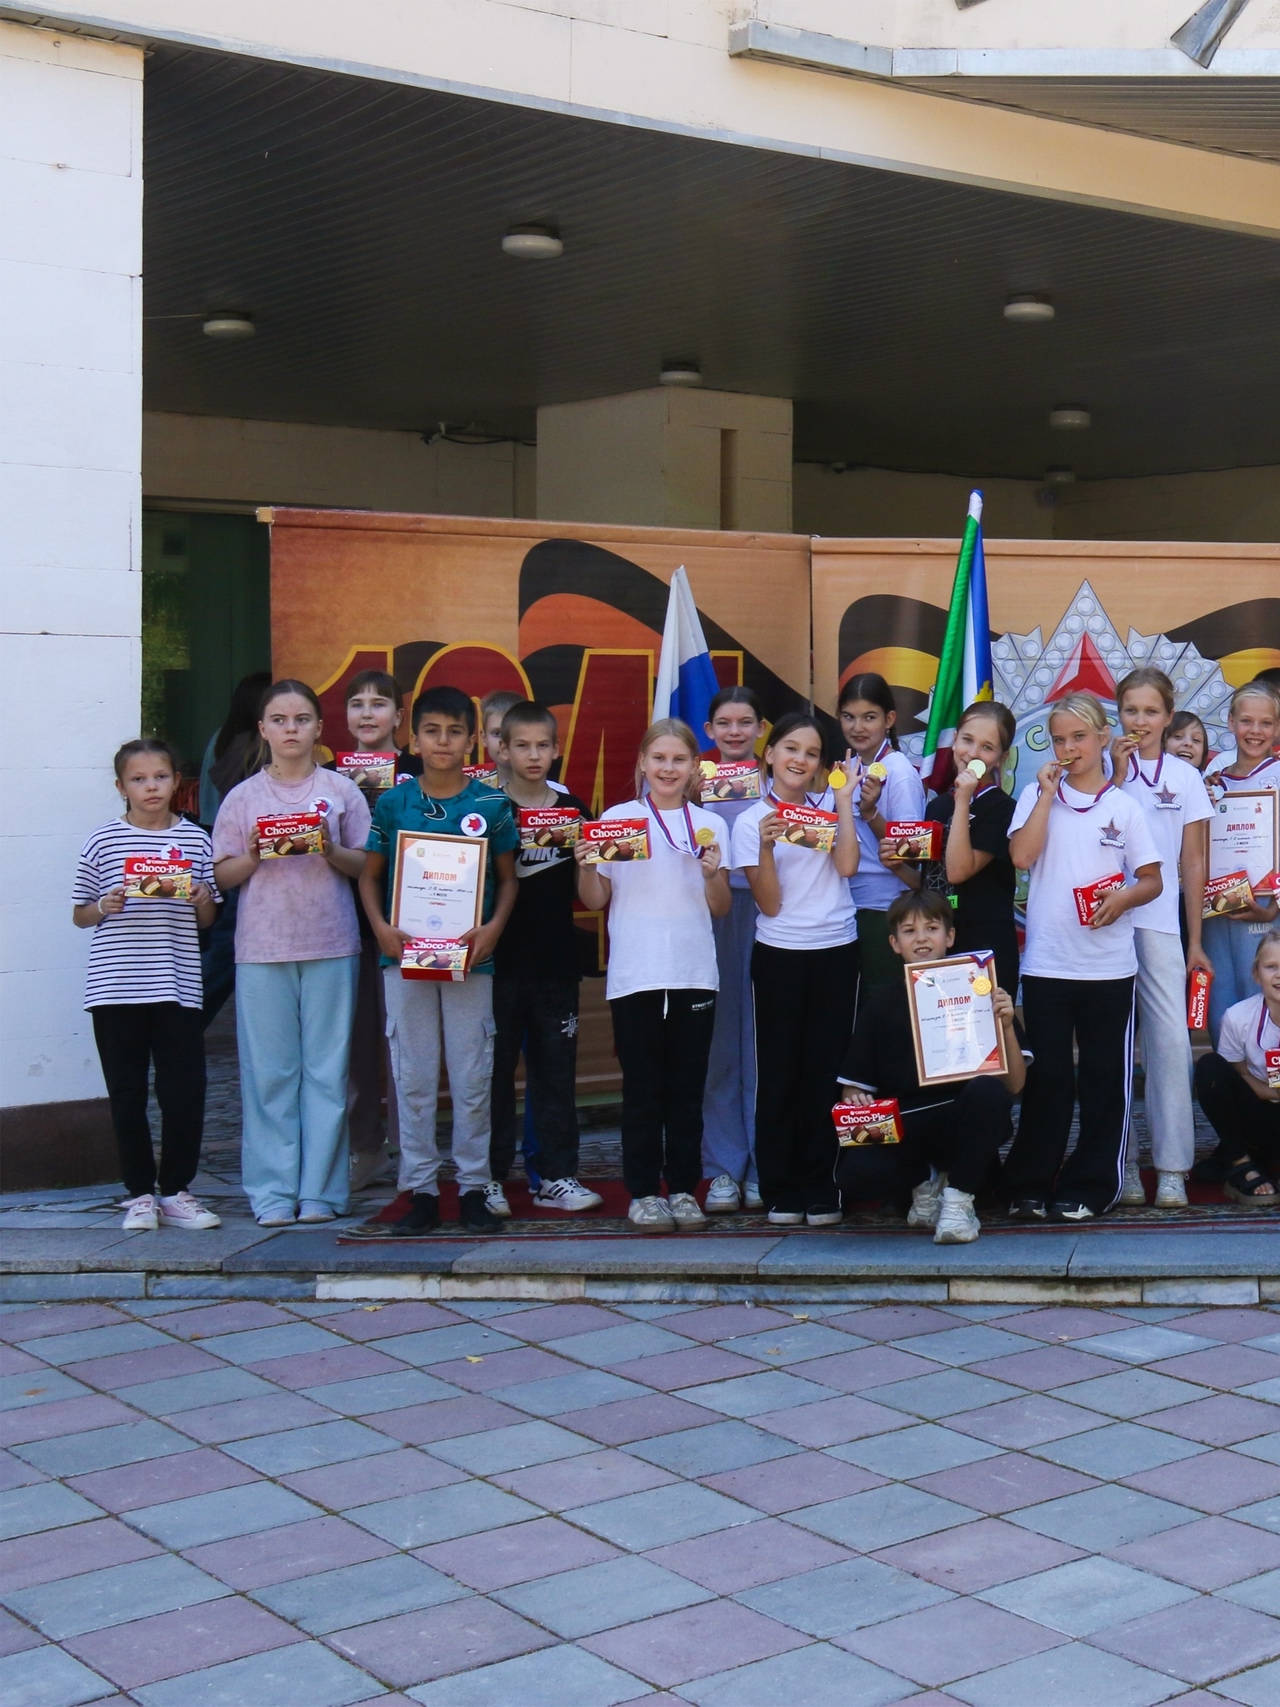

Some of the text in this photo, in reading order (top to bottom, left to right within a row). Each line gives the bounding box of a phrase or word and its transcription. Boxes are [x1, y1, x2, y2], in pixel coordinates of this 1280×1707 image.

[343, 755, 389, 766] Choco-Pie
[716, 766, 751, 777] oco-Pie
[528, 815, 572, 825] Choco-Pie
[783, 809, 829, 825] Choco-Pie
[264, 824, 313, 835] Choco-Pie
[590, 828, 638, 838] Choco-Pie
[891, 826, 927, 836] Choco-Pie
[1226, 823, 1256, 832] ДИПЛОМ
[522, 847, 560, 861] NIKE
[133, 862, 184, 873] Choco-Pie
[423, 870, 457, 881] ДИПЛОМ
[937, 996, 971, 1008] ДИПЛОМ
[1194, 987, 1206, 1028] Choco-Pie
[840, 1113, 885, 1124] Choco-Pie
